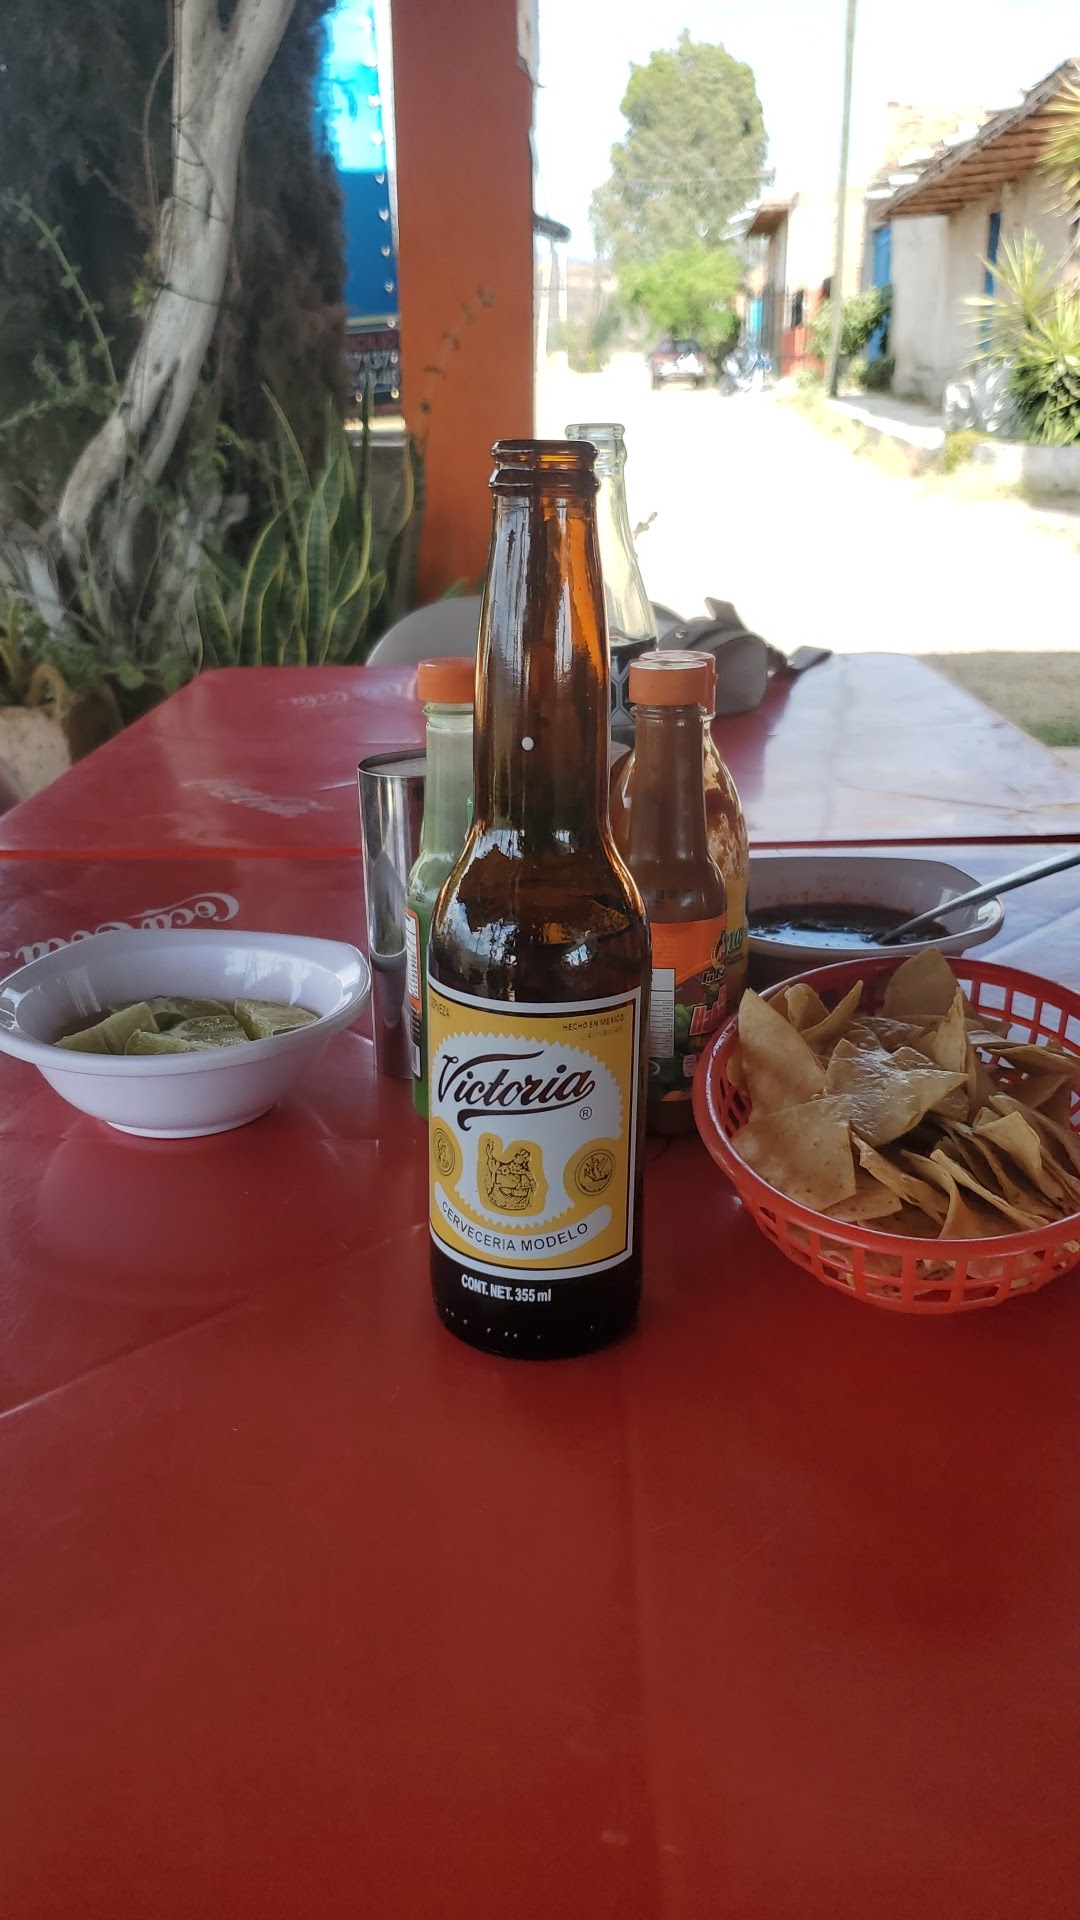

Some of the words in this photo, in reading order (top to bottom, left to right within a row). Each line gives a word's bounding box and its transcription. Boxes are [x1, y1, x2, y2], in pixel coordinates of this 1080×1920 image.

[563, 1021, 588, 1031] HECHO
[589, 1020, 599, 1029] EN
[438, 1050, 596, 1132] Victoria
[442, 1201, 516, 1252] CERVECERIA
[521, 1222, 589, 1252] MODELO
[461, 1273, 489, 1296] CONT.
[490, 1283, 514, 1301] NET.
[514, 1287, 536, 1302] 355
[537, 1288, 552, 1302] ml
